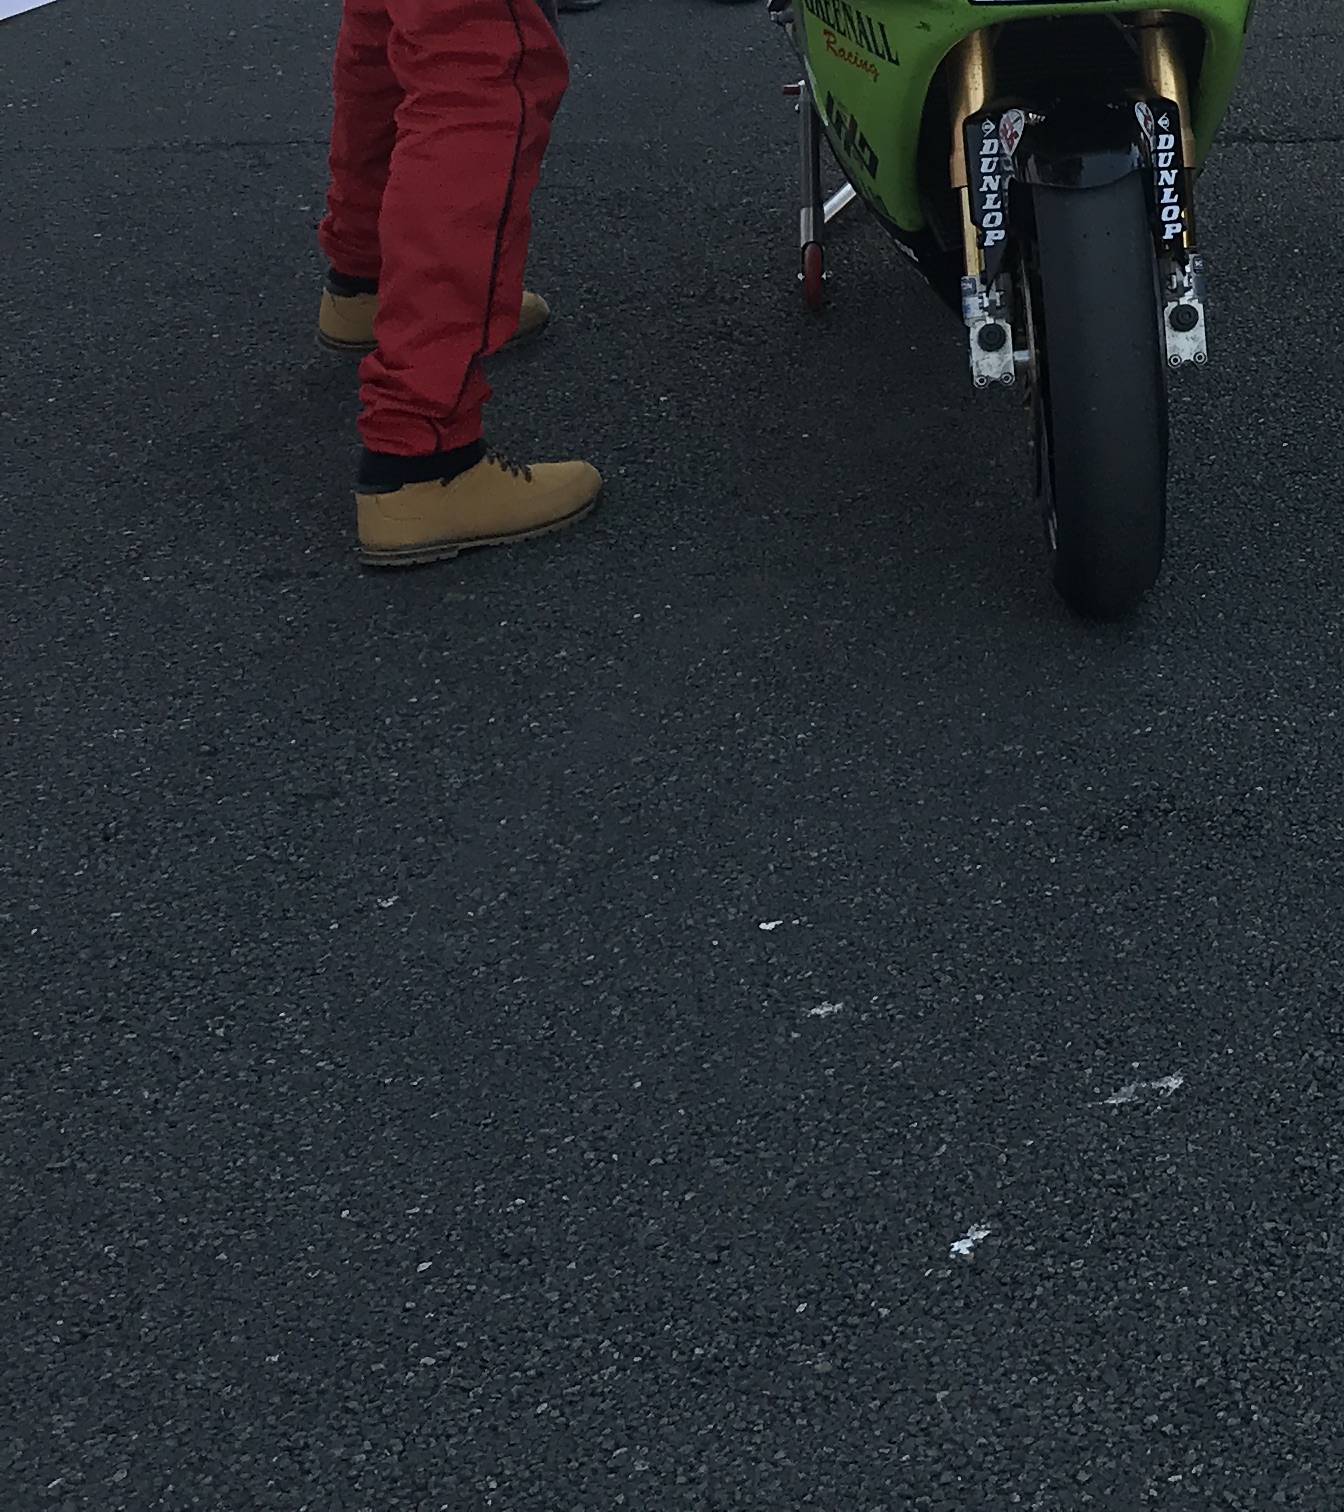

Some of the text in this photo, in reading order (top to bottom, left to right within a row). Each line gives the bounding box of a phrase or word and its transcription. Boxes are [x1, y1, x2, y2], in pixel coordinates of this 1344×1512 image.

[822, 28, 881, 84] Racing
[978, 136, 1007, 248] DUNLOP
[1155, 132, 1184, 242] DUNLOP
